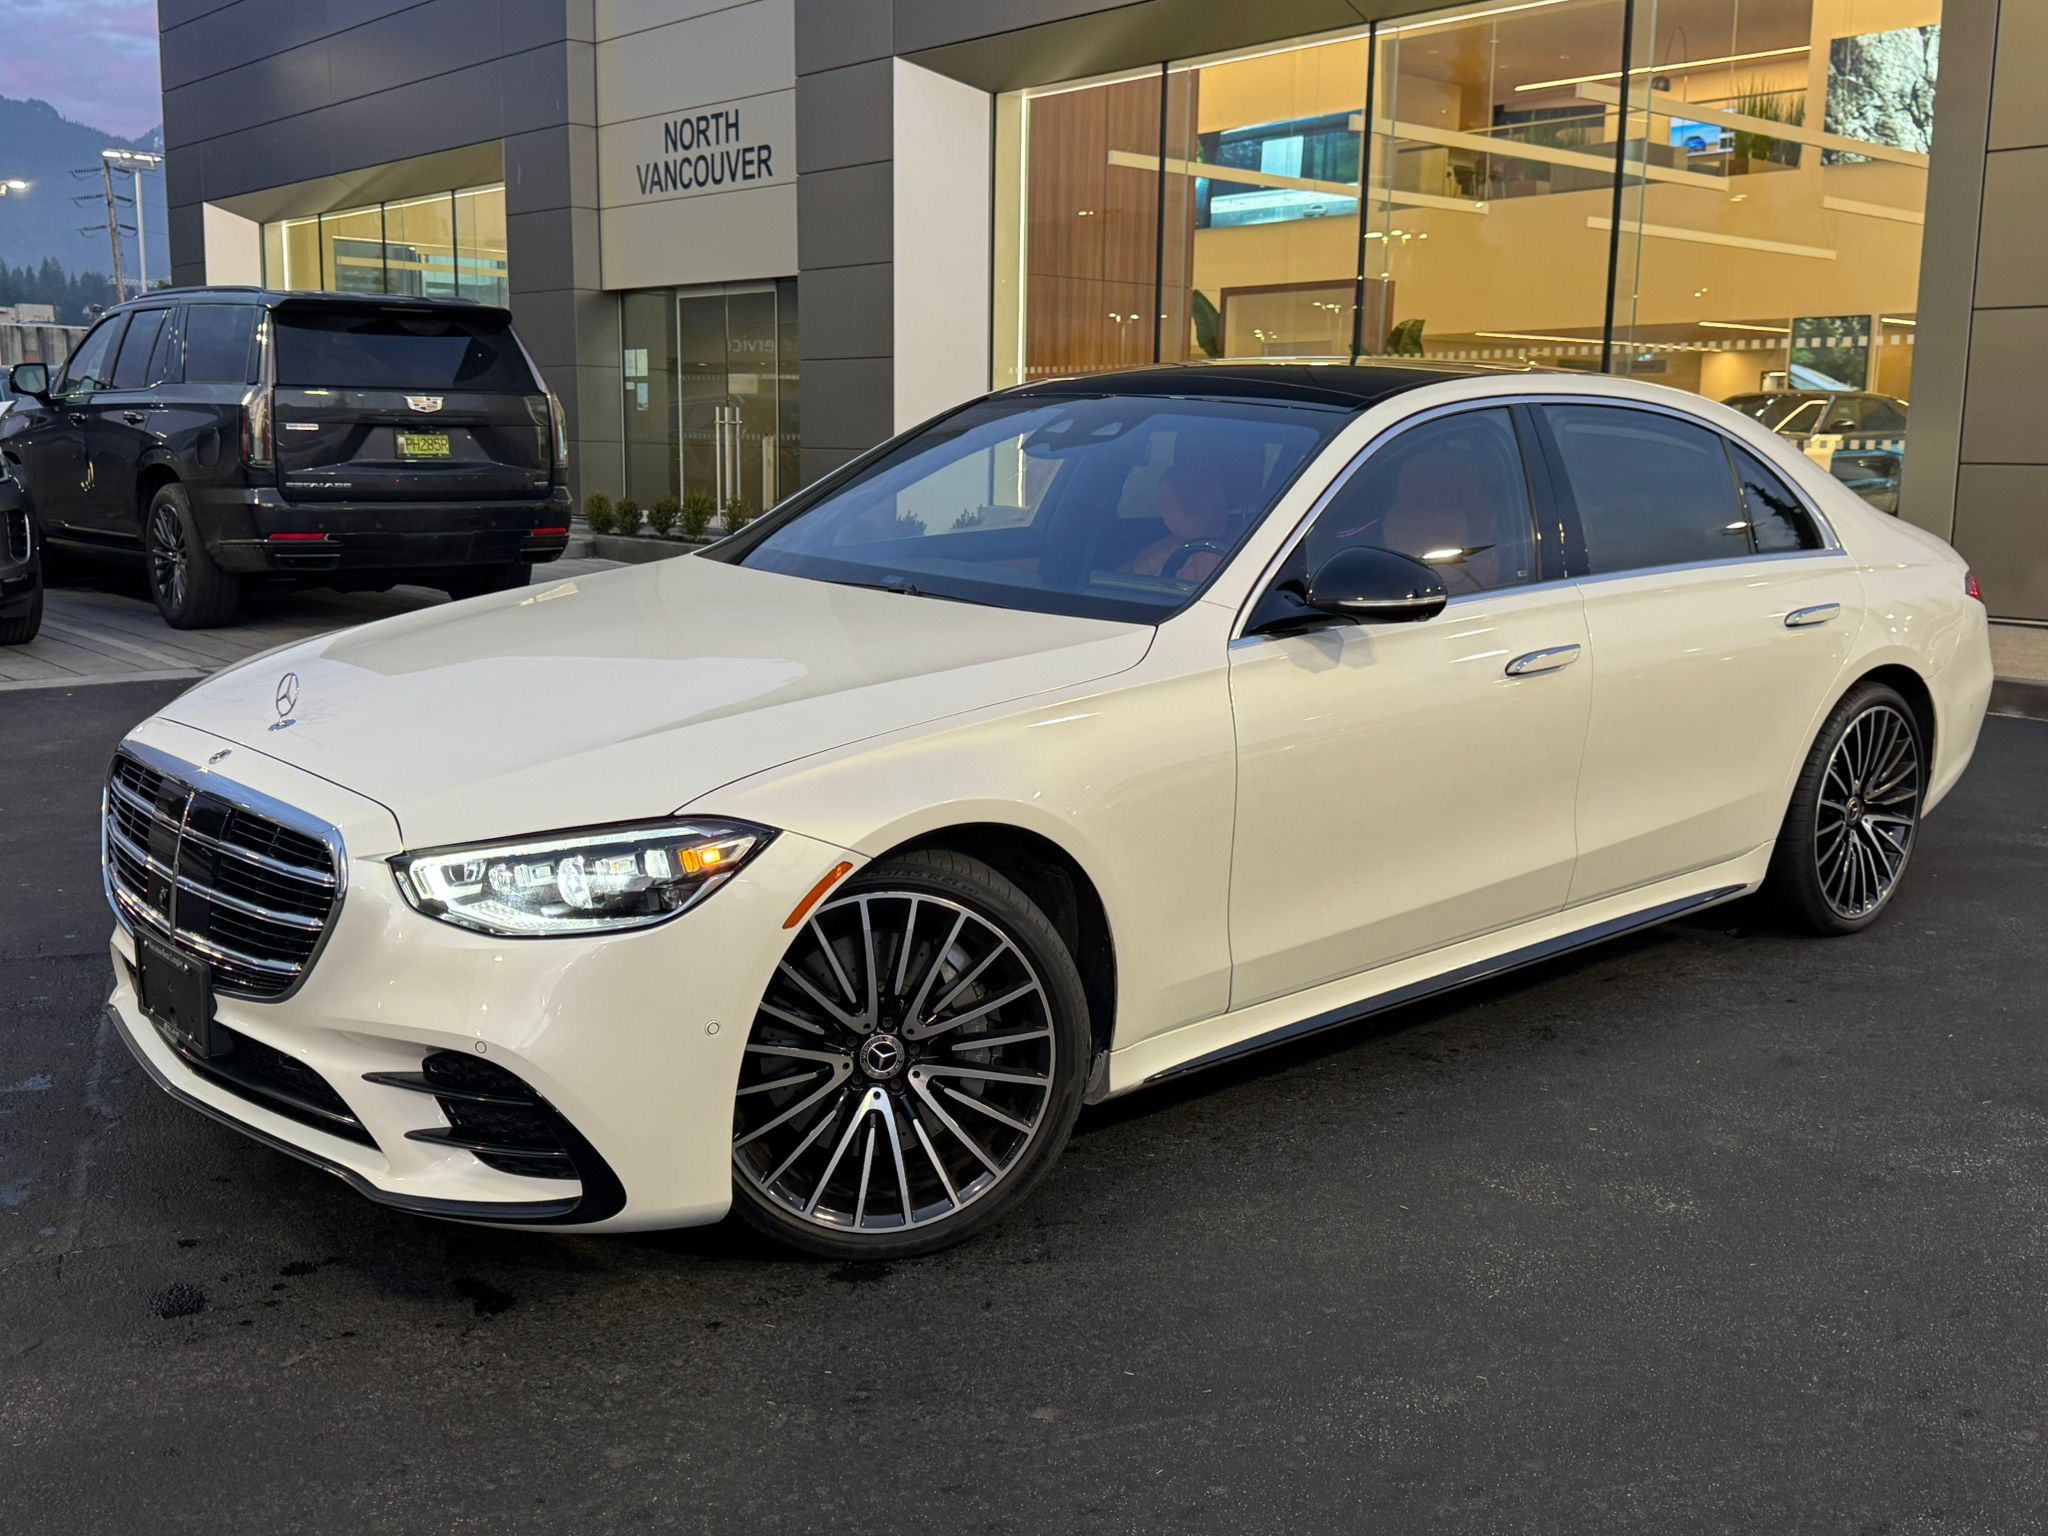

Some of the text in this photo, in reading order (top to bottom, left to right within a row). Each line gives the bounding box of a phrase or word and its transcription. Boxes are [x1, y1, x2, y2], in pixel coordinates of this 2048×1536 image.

[664, 109, 739, 154] NORTH
[636, 144, 773, 195] VANCOUVER
[405, 437, 448, 451] PH285R
